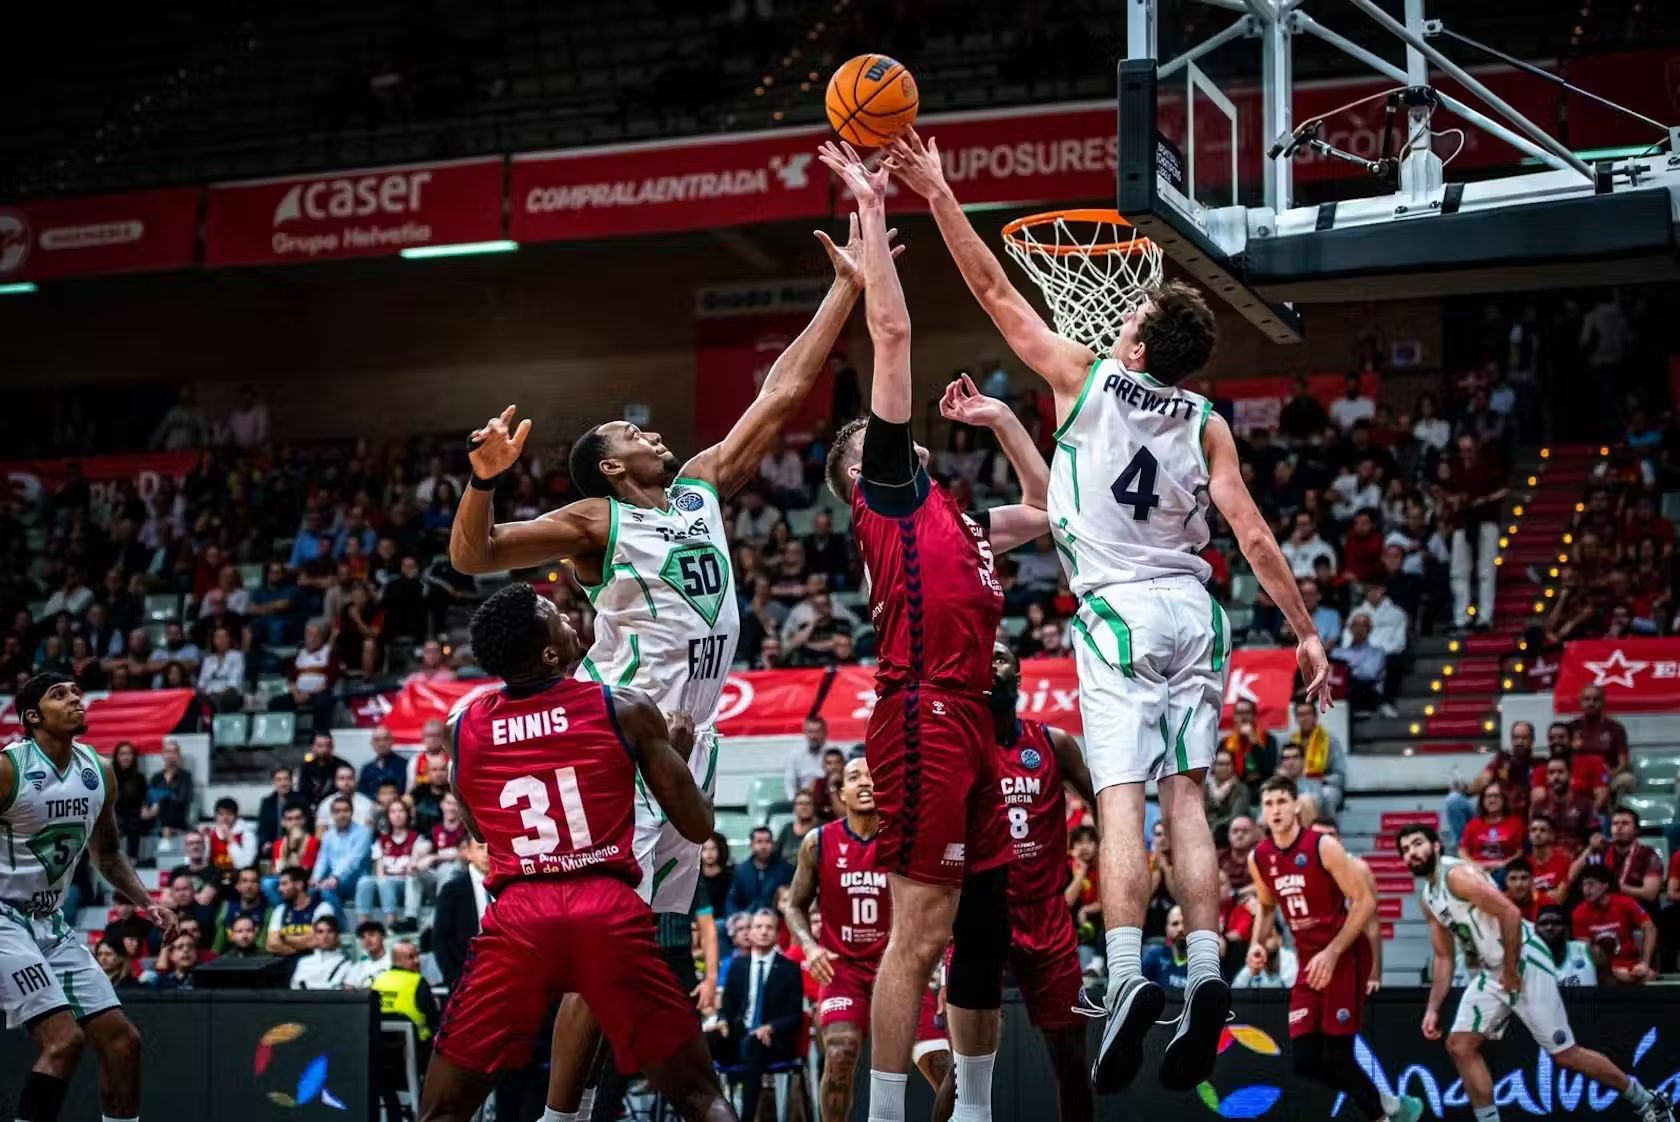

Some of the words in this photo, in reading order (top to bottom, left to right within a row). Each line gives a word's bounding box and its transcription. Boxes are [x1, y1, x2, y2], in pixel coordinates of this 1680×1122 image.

[304, 171, 432, 220] caser
[526, 168, 767, 213] COMPRALAENTRADA
[272, 231, 338, 256] Grupo
[343, 221, 432, 248] Helvetia
[1103, 374, 1196, 420] PREWITT
[1110, 445, 1160, 521] 4
[679, 553, 720, 597] 50
[688, 635, 727, 682] FIAT
[492, 706, 569, 746] ENNIS
[1000, 776, 1041, 796] CAM
[1004, 794, 1033, 804] URCIA
[499, 766, 593, 857] 31
[1007, 806, 1029, 840] 8
[53, 832, 71, 866] 5
[542, 863, 560, 874] de
[840, 871, 887, 889] UCAM
[852, 897, 878, 925] 10
[1286, 895, 1309, 917] 14
[12, 963, 51, 997] FIAT
